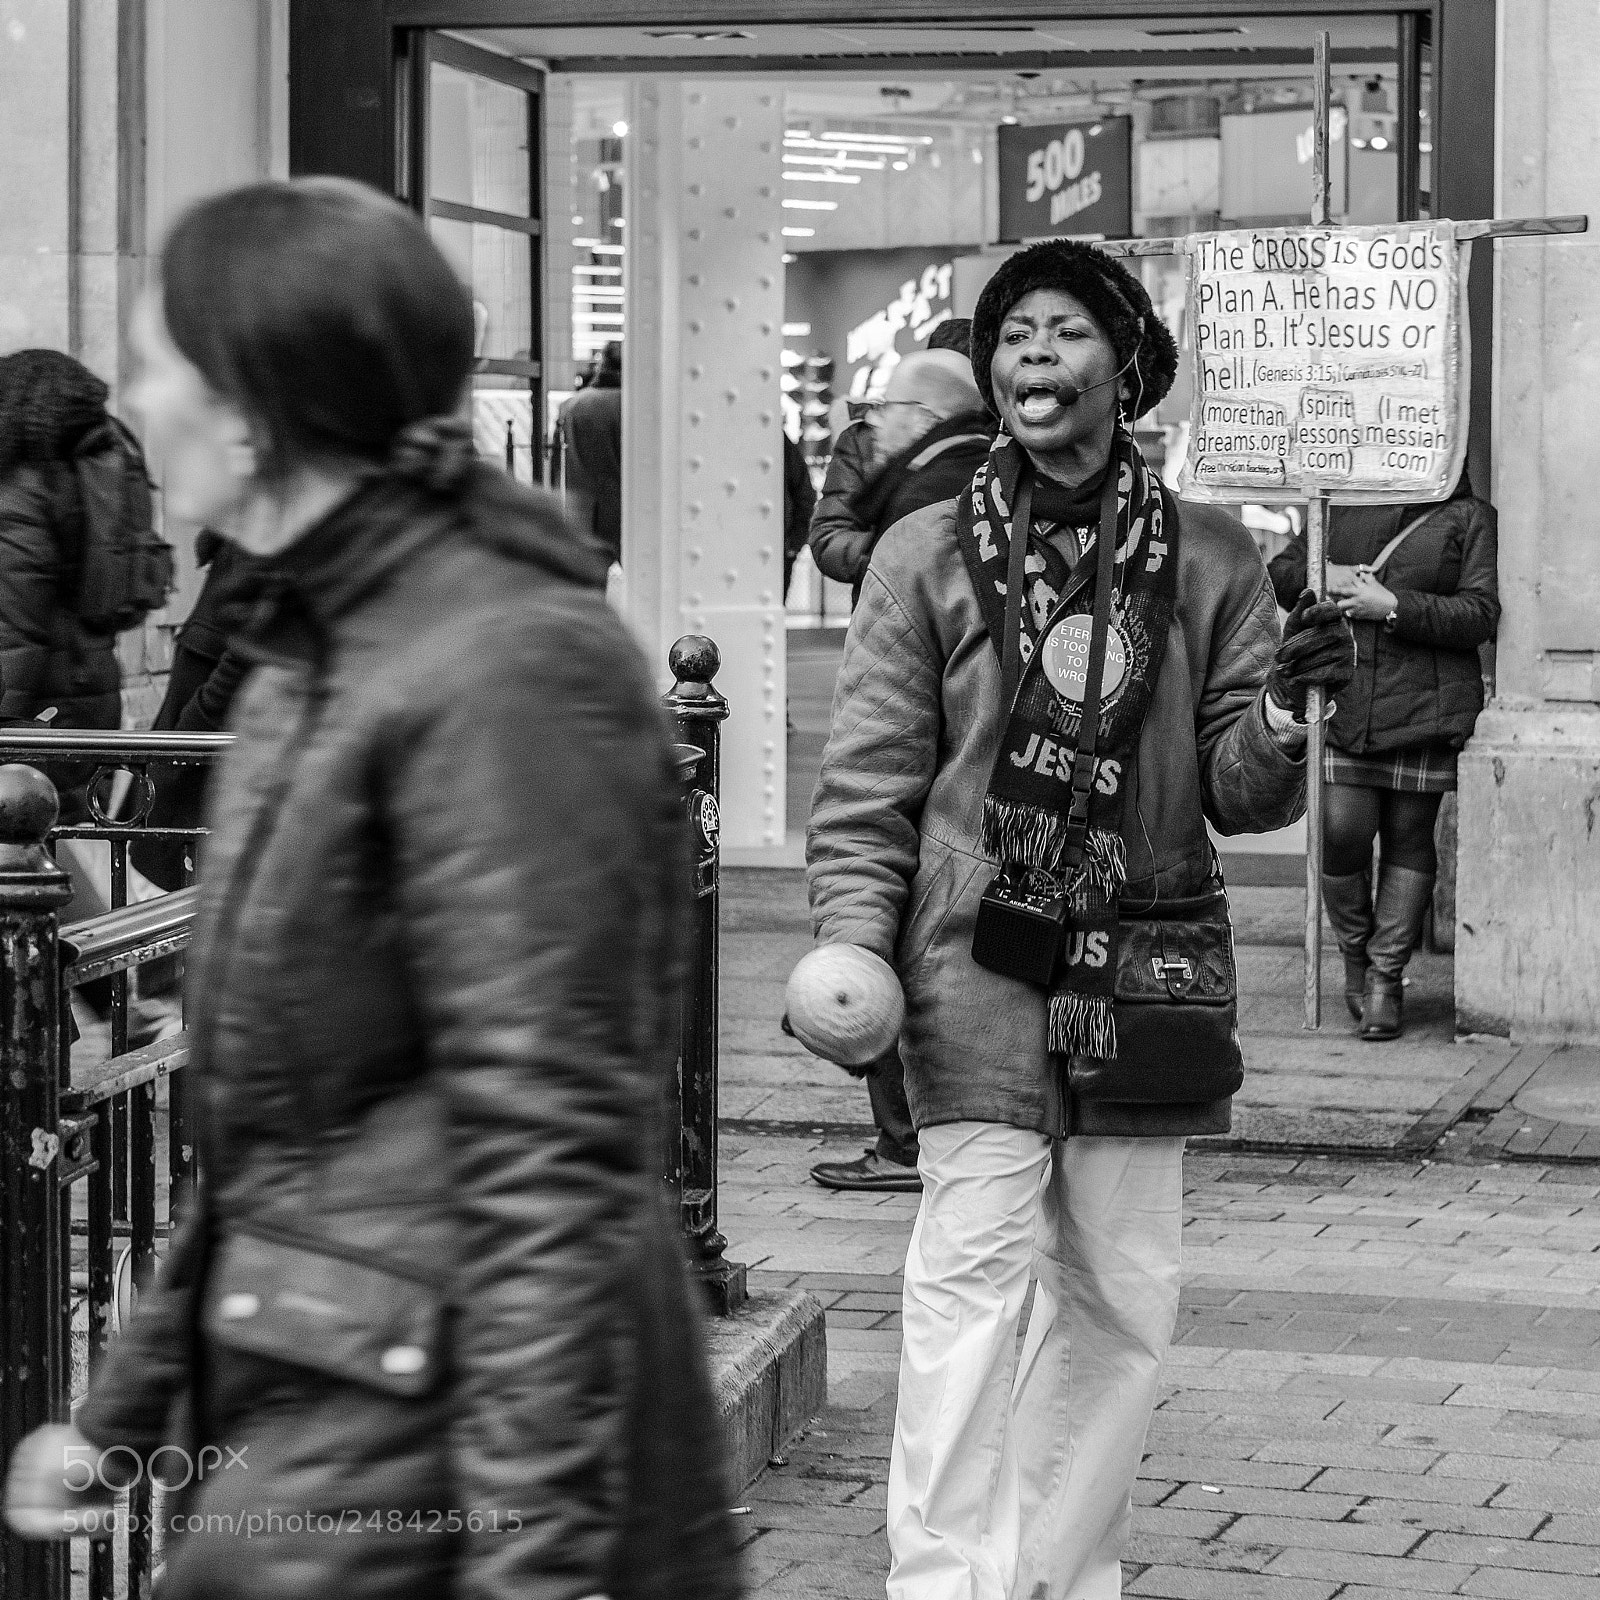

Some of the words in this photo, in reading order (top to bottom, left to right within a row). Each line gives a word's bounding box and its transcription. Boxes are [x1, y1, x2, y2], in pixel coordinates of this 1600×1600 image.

[1026, 128, 1084, 203] 500
[1198, 238, 1243, 271] The
[1200, 281, 1254, 314] Plan
[1262, 280, 1284, 311] A.
[1292, 278, 1320, 310] He
[1326, 277, 1376, 310] has
[1389, 279, 1437, 311] NO
[1198, 321, 1244, 350] Plan
[1254, 318, 1274, 348] B.
[1318, 316, 1390, 348] Jesus
[1403, 325, 1436, 349] or
[1202, 356, 1251, 391] hell.
[1398, 405, 1439, 425] met
[1295, 421, 1360, 445] lessons
[1366, 426, 1446, 450] messiah
[1063, 640, 1088, 653] TOO
[1067, 655, 1083, 667] TO
[1058, 668, 1087, 683] WRO
[1010, 733, 1122, 796] JESS
